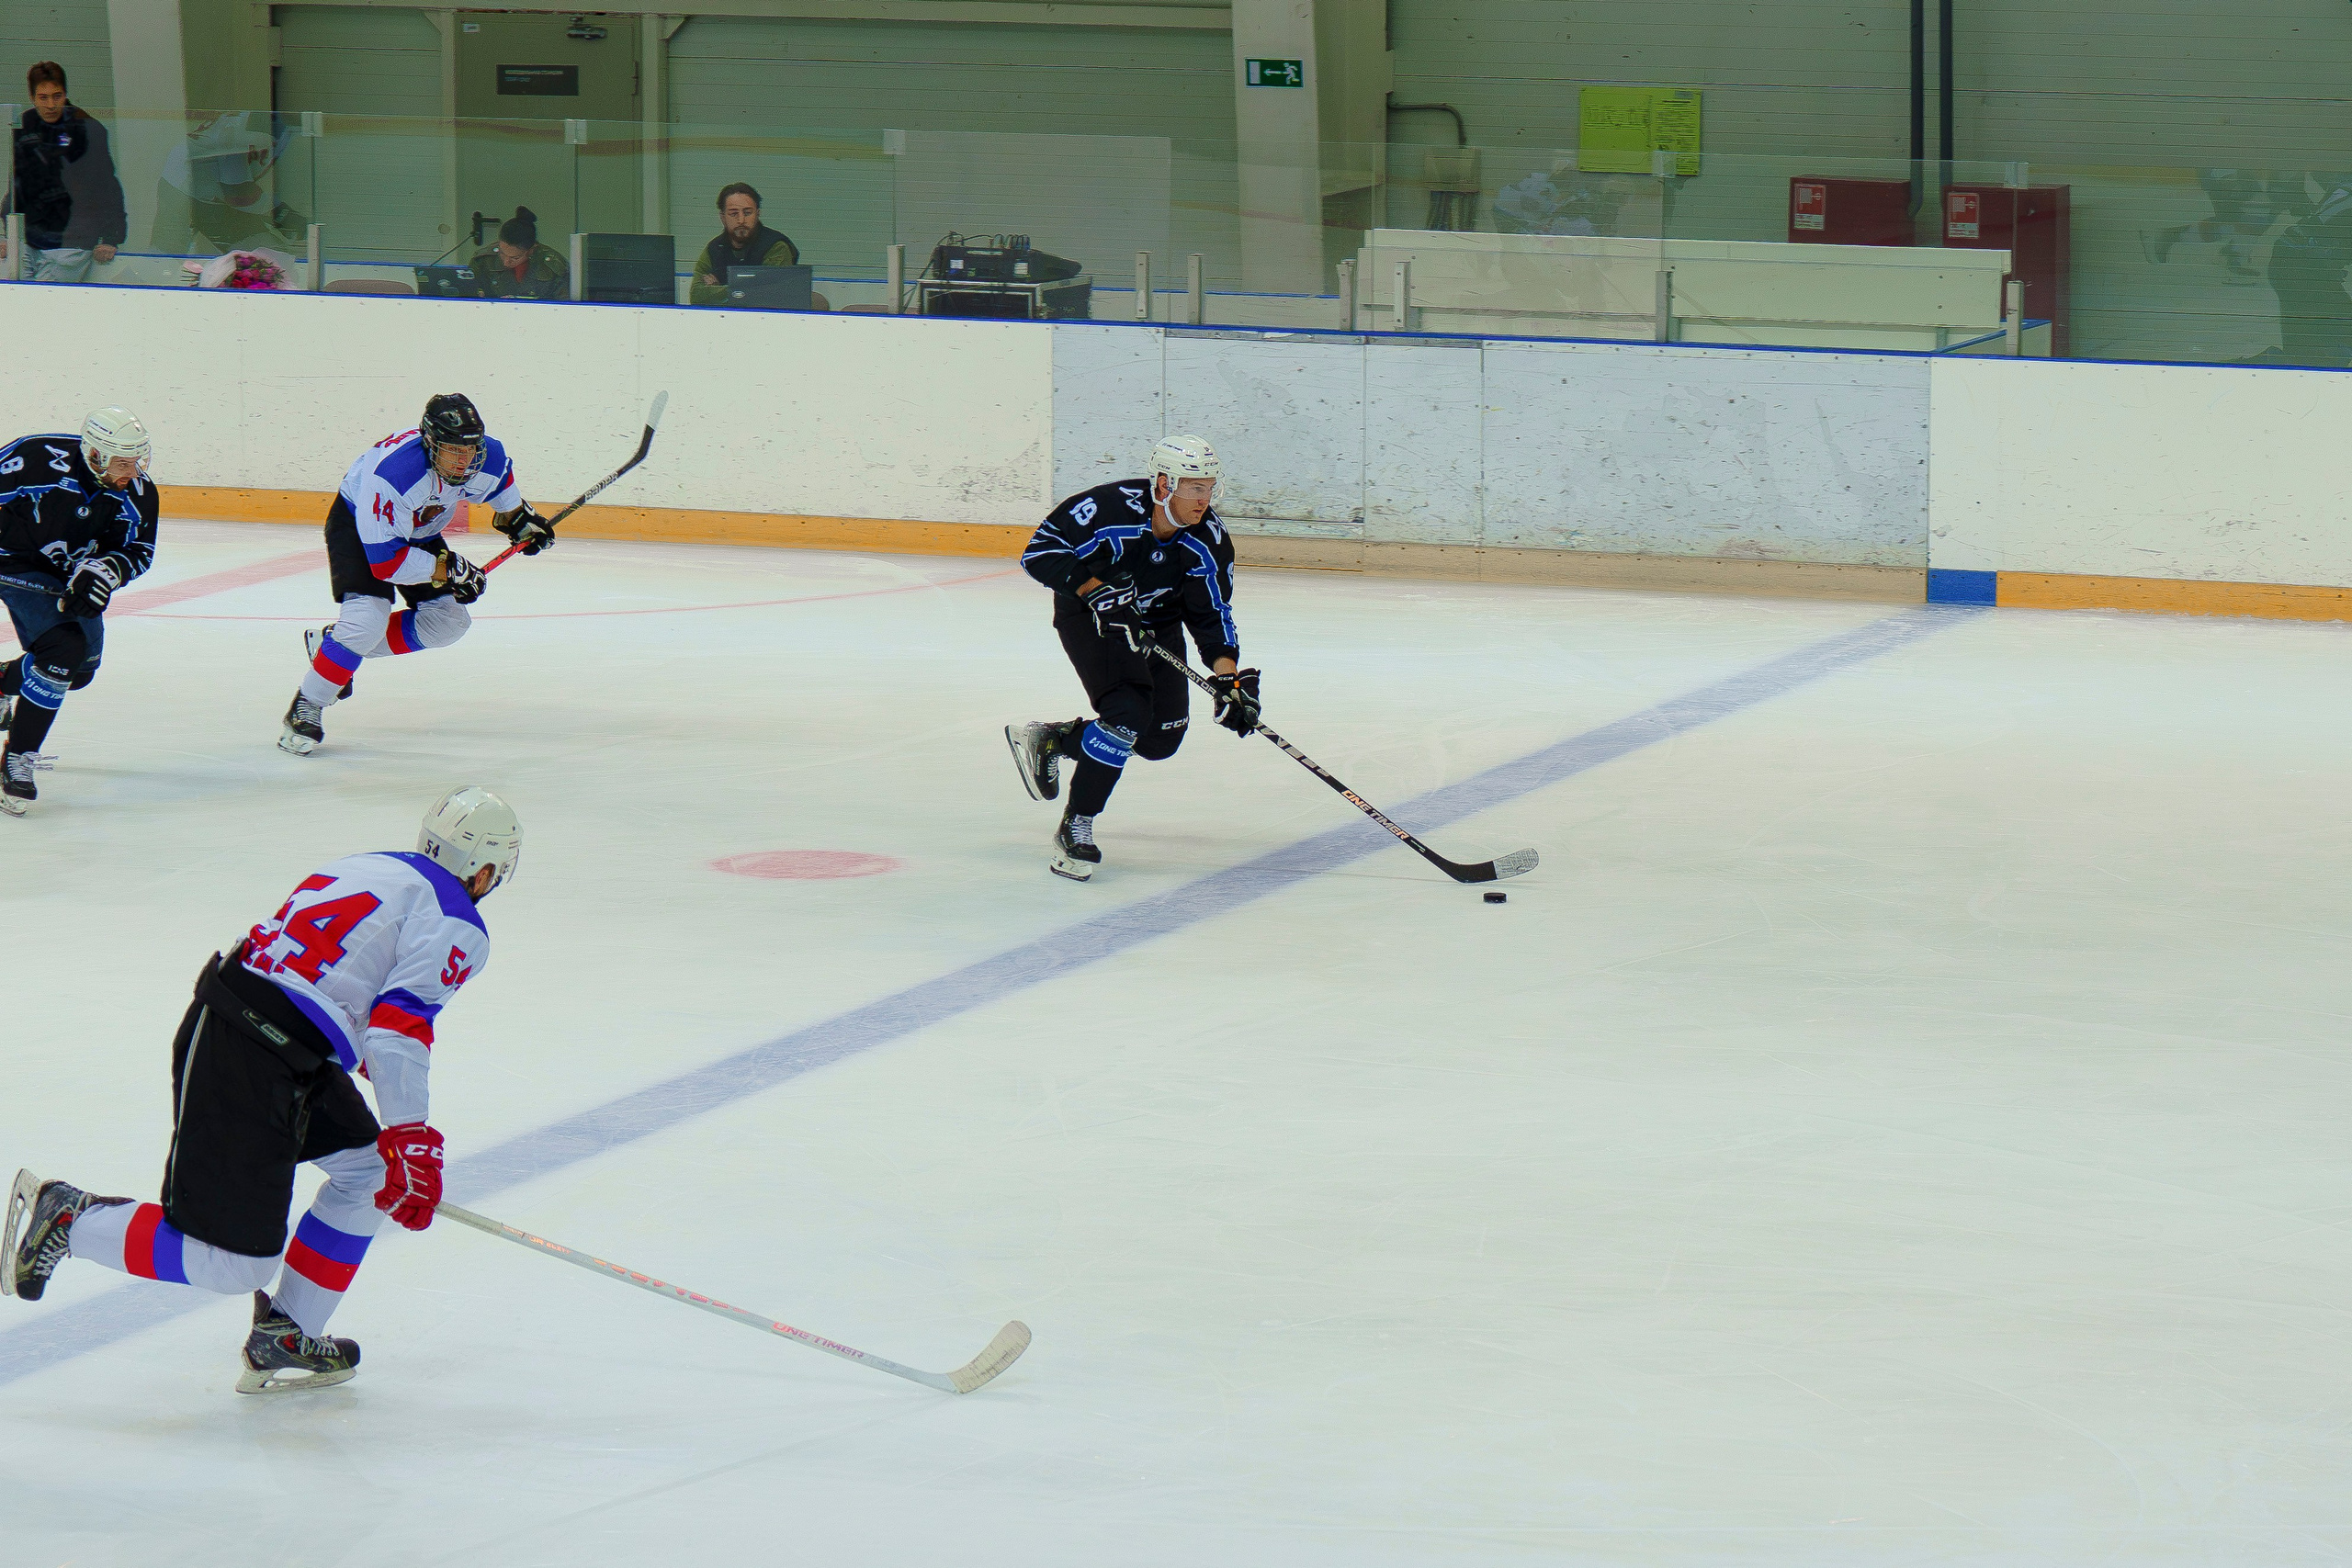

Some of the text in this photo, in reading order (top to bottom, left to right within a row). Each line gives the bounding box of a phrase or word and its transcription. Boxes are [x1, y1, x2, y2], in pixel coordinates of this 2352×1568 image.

[372, 492, 395, 527] 44
[1069, 497, 1098, 526] 19
[1153, 644, 1217, 696] DOMINATOR
[1098, 742, 1117, 754] ONE
[1341, 789, 1410, 840] ONE TIMER
[424, 838, 441, 859] 54
[249, 873, 383, 986] 54
[772, 1321, 865, 1359] ONE TIMER
